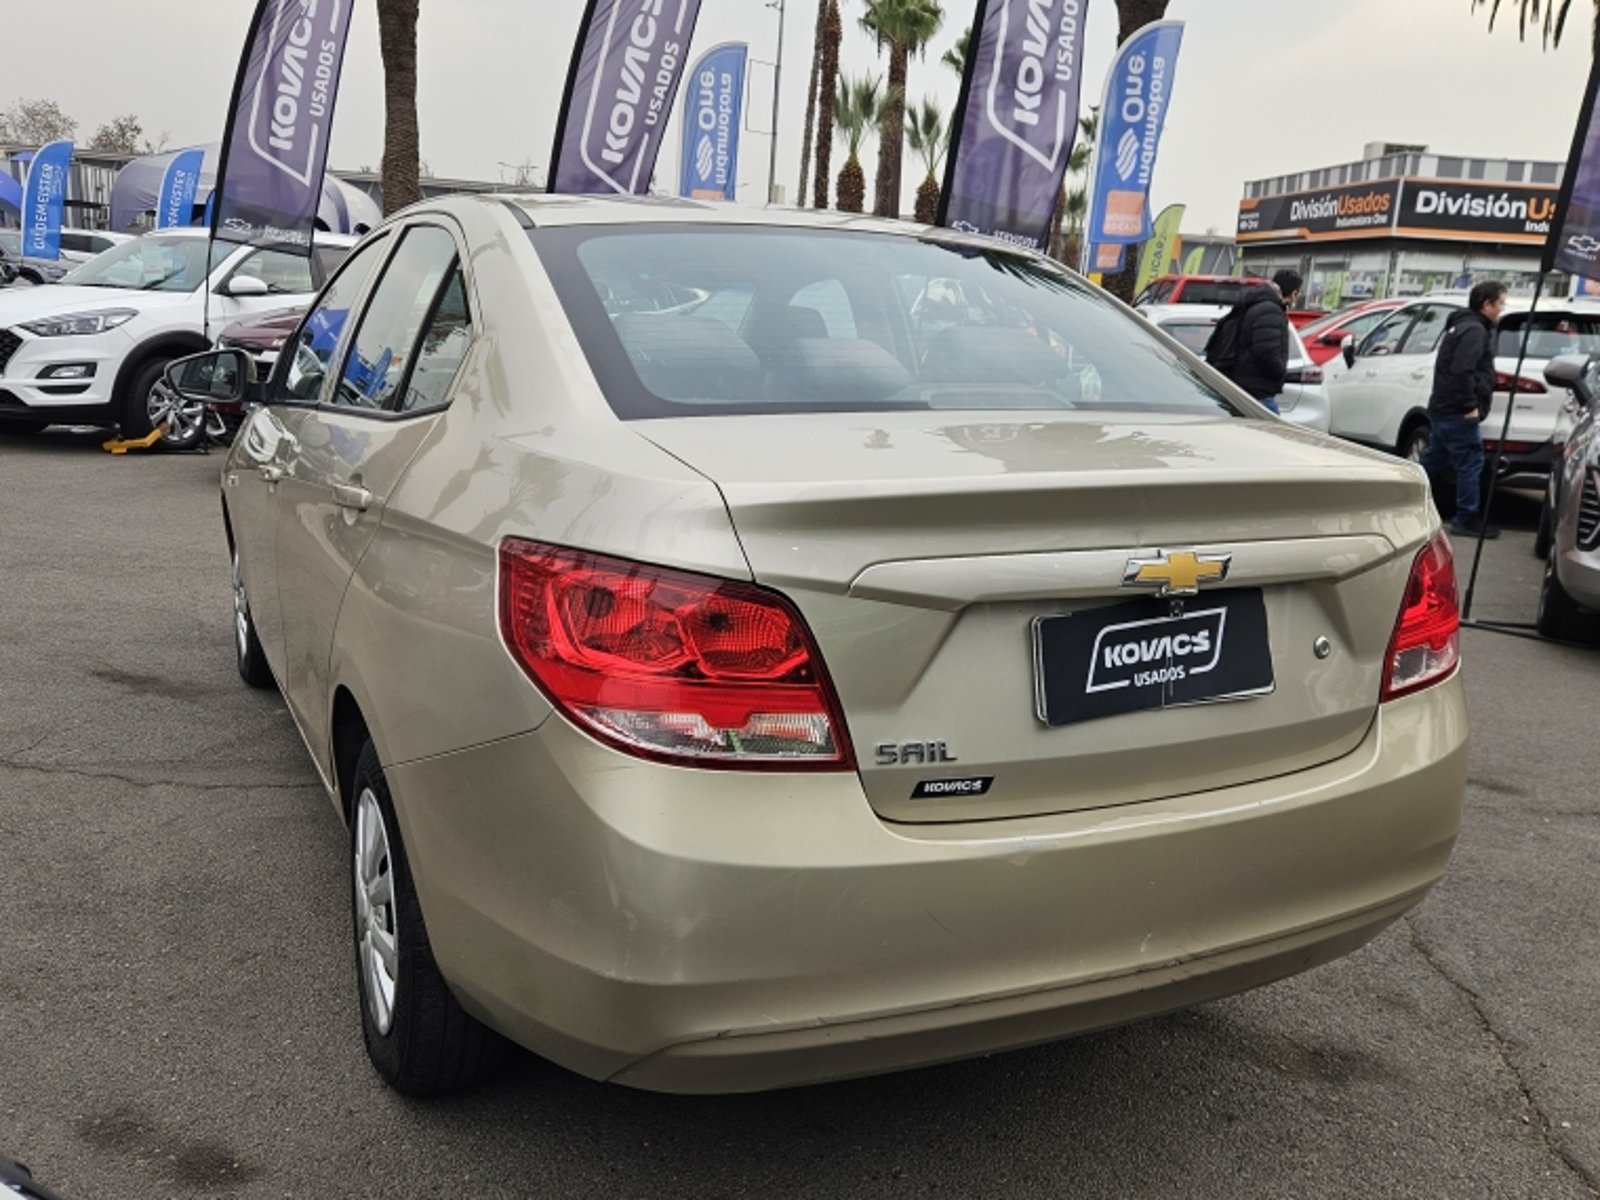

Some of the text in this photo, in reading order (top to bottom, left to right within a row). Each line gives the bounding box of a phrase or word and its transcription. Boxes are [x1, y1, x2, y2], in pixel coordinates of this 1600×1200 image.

[309, 38, 337, 117] USADOS
[645, 40, 680, 126] USADOS
[1104, 629, 1211, 669] KOVACS
[1133, 666, 1186, 687] USADOS
[923, 780, 982, 793] KOVACS
